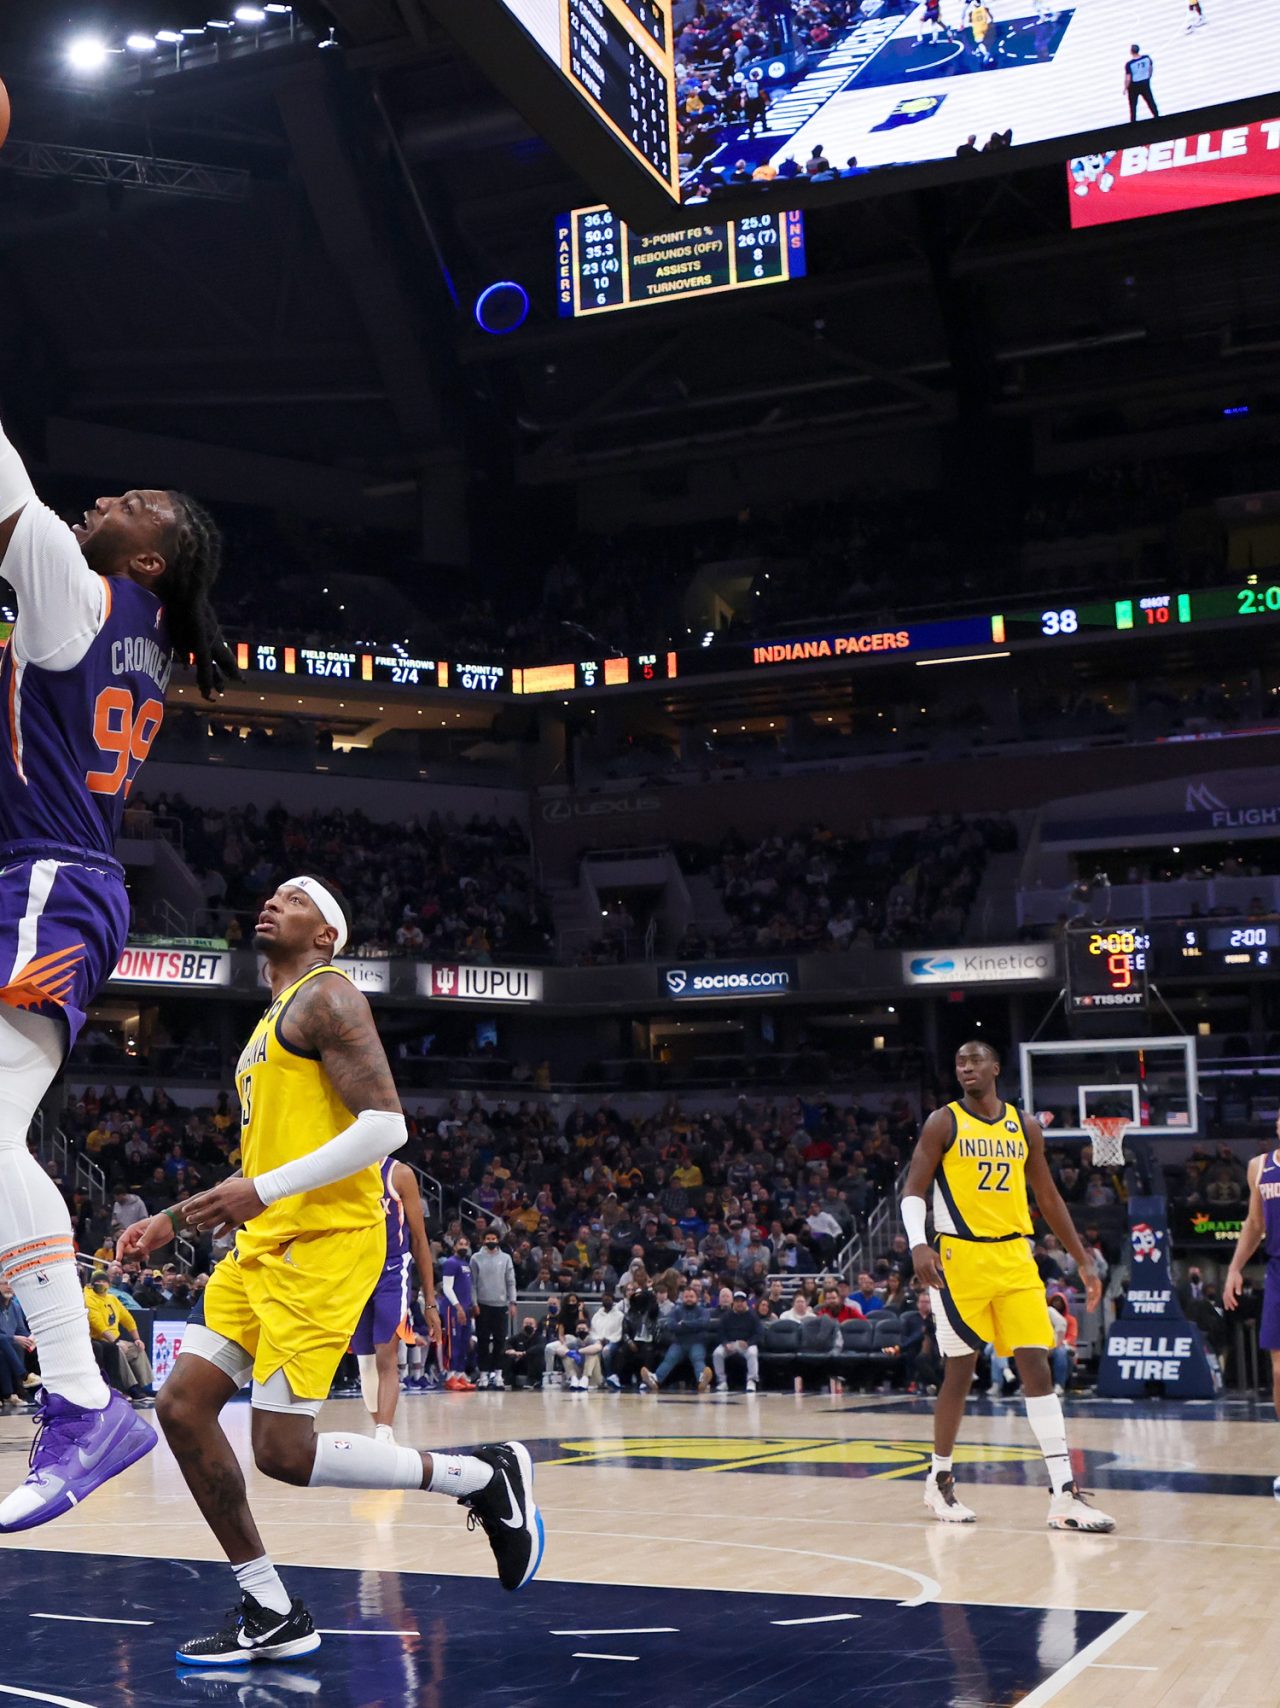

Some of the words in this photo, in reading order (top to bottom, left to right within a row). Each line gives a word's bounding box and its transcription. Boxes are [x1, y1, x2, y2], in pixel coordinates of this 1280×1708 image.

[1120, 126, 1249, 177] BELLE
[584, 211, 612, 227] 36.6
[741, 214, 771, 231] 25.0
[585, 228, 613, 243] 50.0
[641, 230, 685, 248] 3-POINT
[687, 227, 701, 240] FG
[702, 225, 714, 237] %
[738, 232, 755, 247] 26
[757, 229, 777, 245] (7)
[586, 244, 614, 259] 35.3
[633, 245, 692, 266] REBOUNDS
[693, 240, 723, 257] (OFF)
[753, 248, 763, 261] 8
[558, 228, 570, 303] PACERS
[582, 261, 599, 276] 23
[601, 258, 619, 273] (4)
[655, 260, 701, 278] ASSISTS
[754, 265, 764, 278] 6
[593, 277, 609, 290] 10
[646, 275, 712, 296] TURNOVERS
[597, 293, 606, 305] 6
[1139, 596, 1170, 609] SHOT
[1041, 609, 1078, 635] 38
[1145, 608, 1169, 624] 10
[257, 645, 275, 655] AST
[301, 649, 326, 660] FIELD
[327, 651, 356, 663] GOALS
[753, 640, 831, 664] INDIANA
[834, 631, 910, 656] PACERS
[257, 655, 276, 671] 10
[306, 659, 350, 678] 15/41
[375, 656, 398, 667] FREE
[398, 658, 435, 671] THROWS
[639, 655, 656, 665] FLS
[392, 667, 419, 684] 2/4
[456, 663, 490, 675] 3-POINT
[491, 667, 504, 676] FG
[644, 665, 654, 679] 5
[462, 674, 498, 691] 6/17
[584, 672, 595, 686] 5
[85, 686, 164, 800] 99
[575, 797, 661, 815] LEXUS
[1089, 933, 1134, 955] 2:00
[1230, 929, 1267, 947] 2:00
[964, 955, 1048, 971] Kinetico
[1108, 954, 1132, 989] 9
[465, 969, 529, 997] IUPUI
[1093, 993, 1143, 1006] TISSOT
[959, 1139, 1025, 1160] INDIANA
[977, 1161, 1010, 1192] 22
[1127, 1290, 1171, 1301] BELLE
[1133, 1302, 1165, 1313] TIRE
[1107, 1337, 1193, 1358] BELLE
[1118, 1360, 1181, 1381] TIRE
